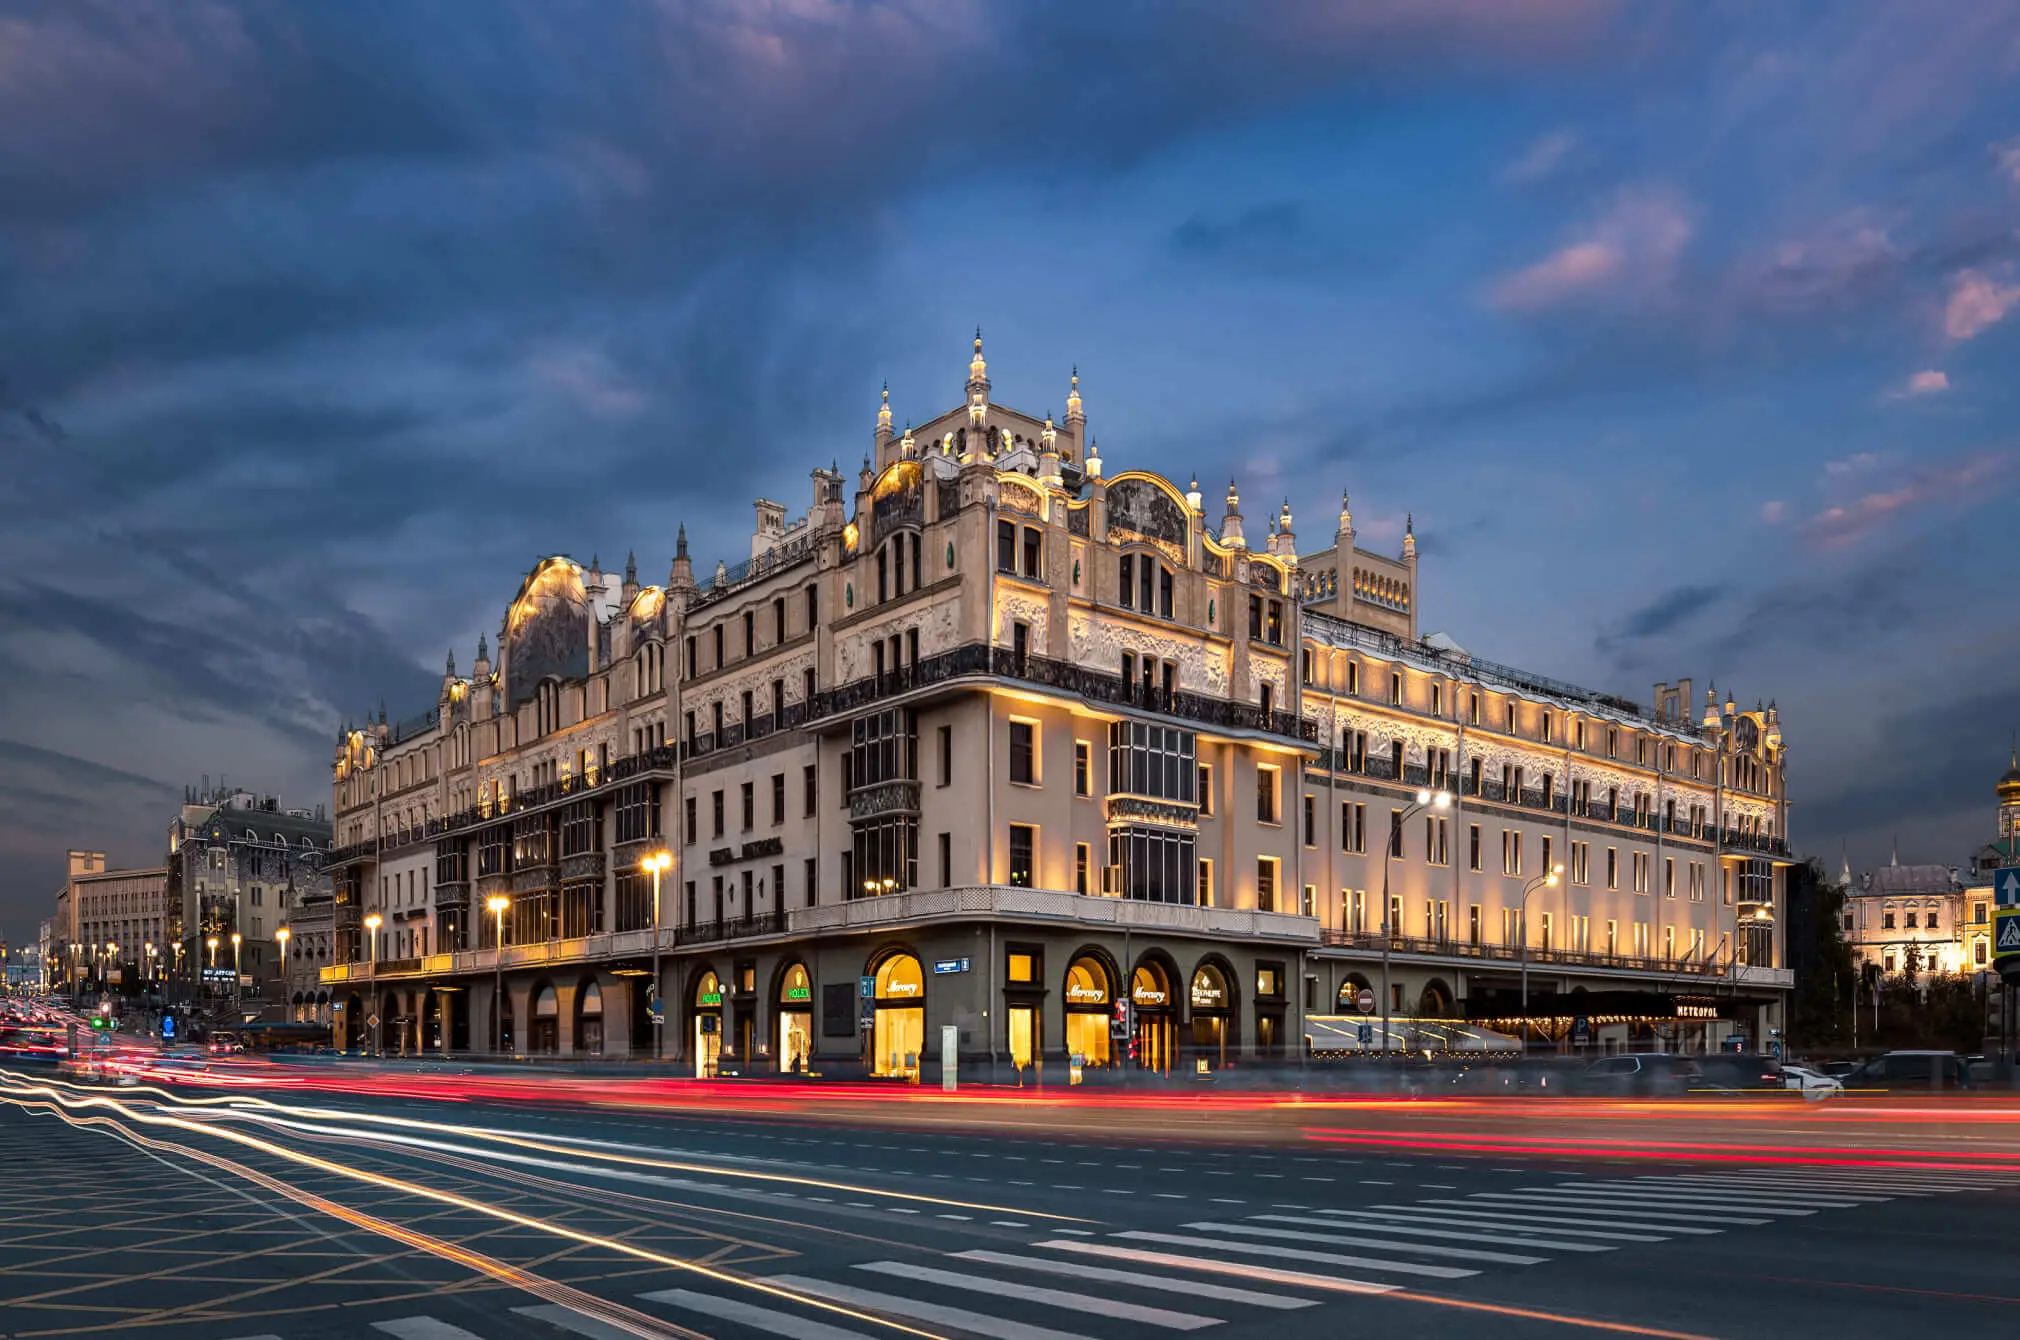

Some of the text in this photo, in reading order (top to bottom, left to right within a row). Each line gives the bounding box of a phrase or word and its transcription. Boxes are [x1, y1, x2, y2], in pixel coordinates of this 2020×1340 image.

[887, 980, 917, 997] Mercury
[1066, 984, 1104, 1001] Mercury
[1135, 986, 1165, 1003] Mercury
[1677, 1006, 1718, 1018] METROPOL
